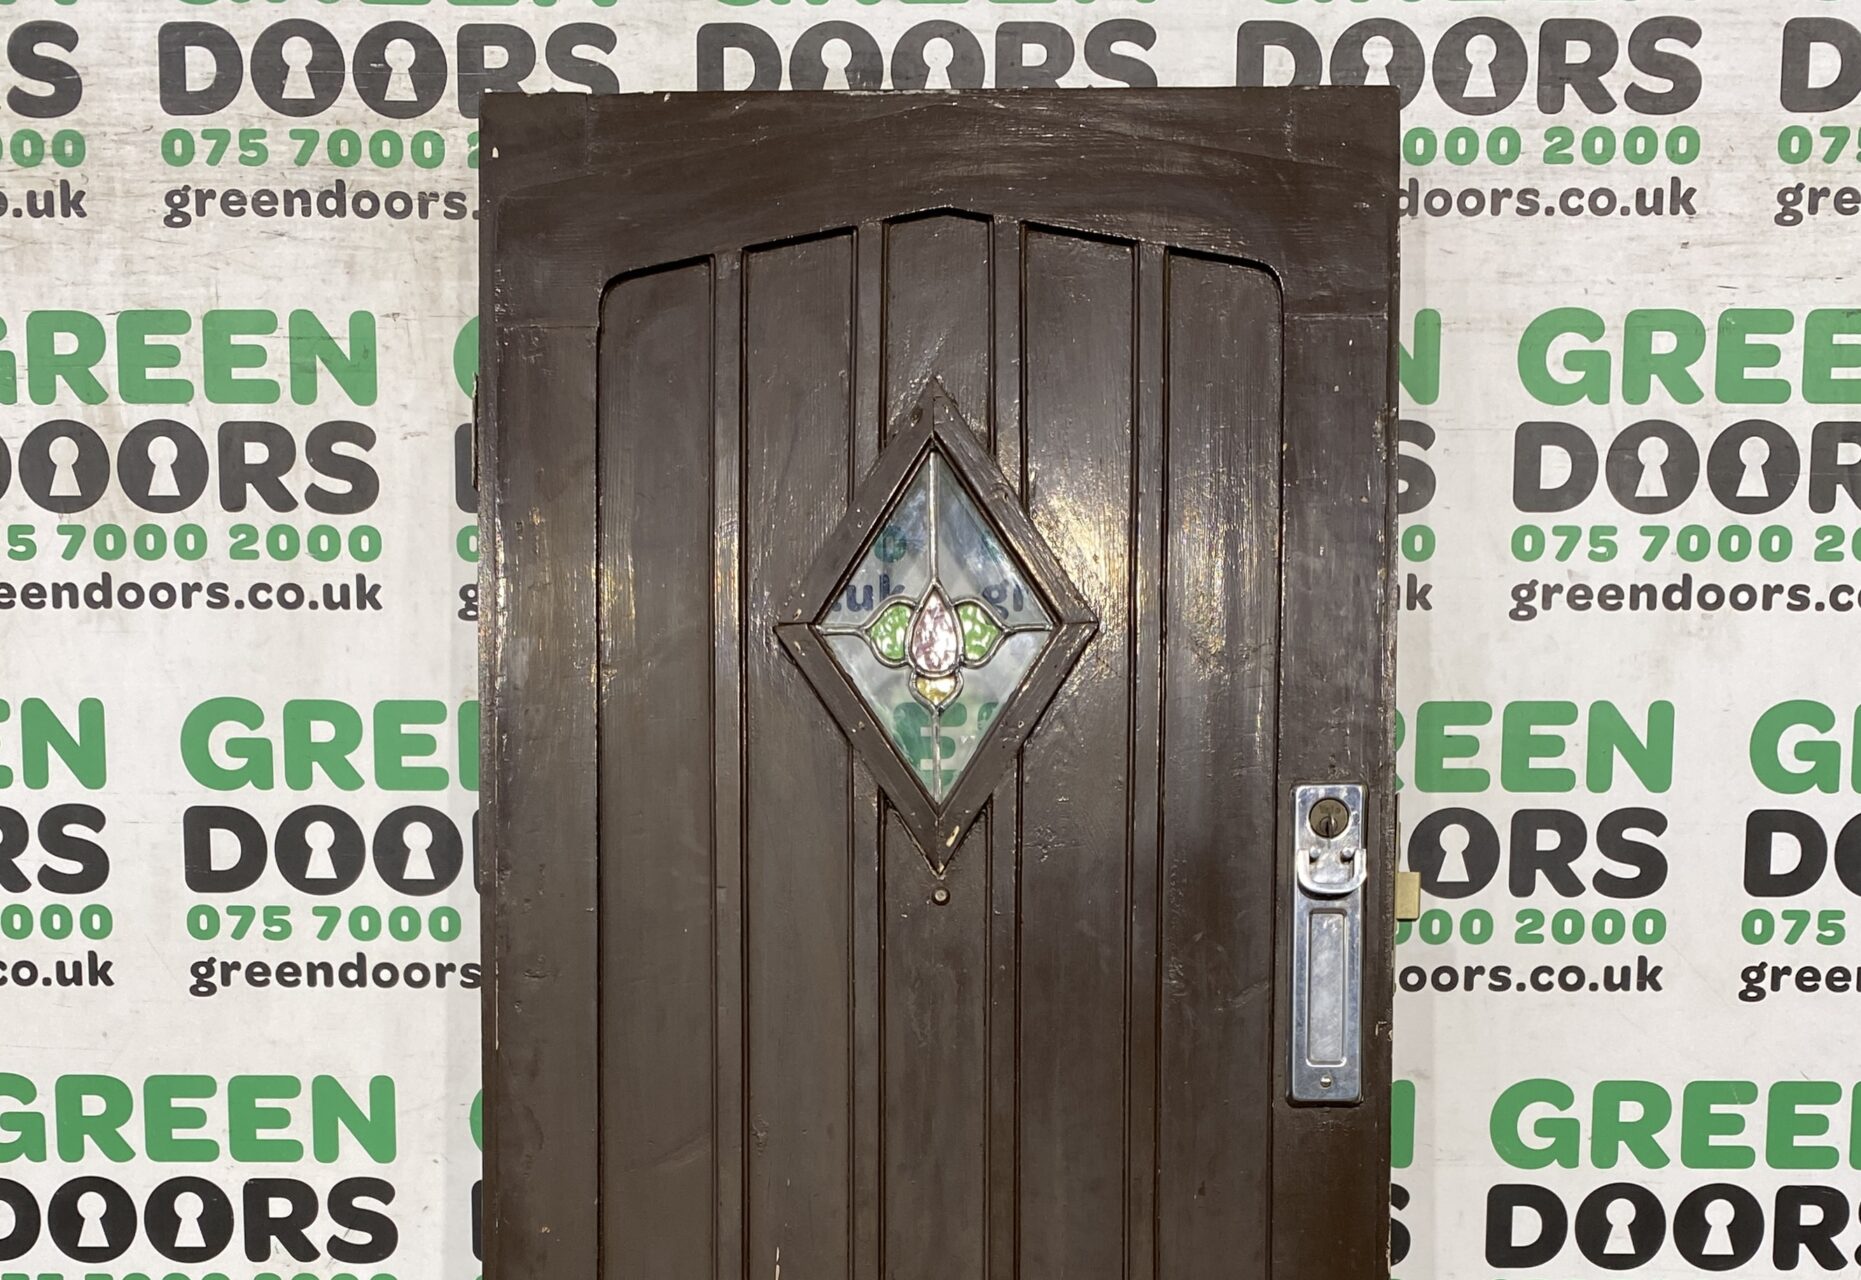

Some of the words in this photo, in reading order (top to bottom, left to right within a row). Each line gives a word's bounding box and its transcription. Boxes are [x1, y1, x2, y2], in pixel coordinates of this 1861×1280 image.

[157, 18, 620, 120] DOORS
[696, 18, 1159, 92] DOORS
[1235, 15, 1703, 116] DOORS
[0, 128, 86, 168] 00
[161, 128, 268, 166] 075
[288, 128, 445, 169] 7000
[1544, 125, 1701, 165] 2000
[1778, 125, 1861, 164] 07
[0, 308, 377, 406] REEN
[1518, 307, 1861, 406] GREE
[0, 418, 380, 515] OORS
[1512, 419, 1861, 515] DOOR
[57, 523, 208, 561] 7000
[228, 523, 382, 563] 2000
[1511, 523, 1617, 562] 075
[1640, 523, 1793, 562] 7000
[1508, 573, 1861, 622] greendoors.c
[0, 697, 106, 790] N
[180, 696, 480, 792] GRE
[1395, 699, 1675, 794] EEN
[1749, 699, 1861, 795] G
[182, 804, 479, 897] DOO
[187, 903, 293, 941] 075
[312, 904, 462, 942] 7000
[1396, 907, 1494, 945] 00
[1514, 907, 1667, 945] 2000
[1740, 907, 1846, 946] 075
[0, 950, 114, 987] o.uk
[1738, 961, 1861, 1003] gree
[1489, 1077, 1861, 1170] GREE
[1485, 1182, 1861, 1272] DOOR
